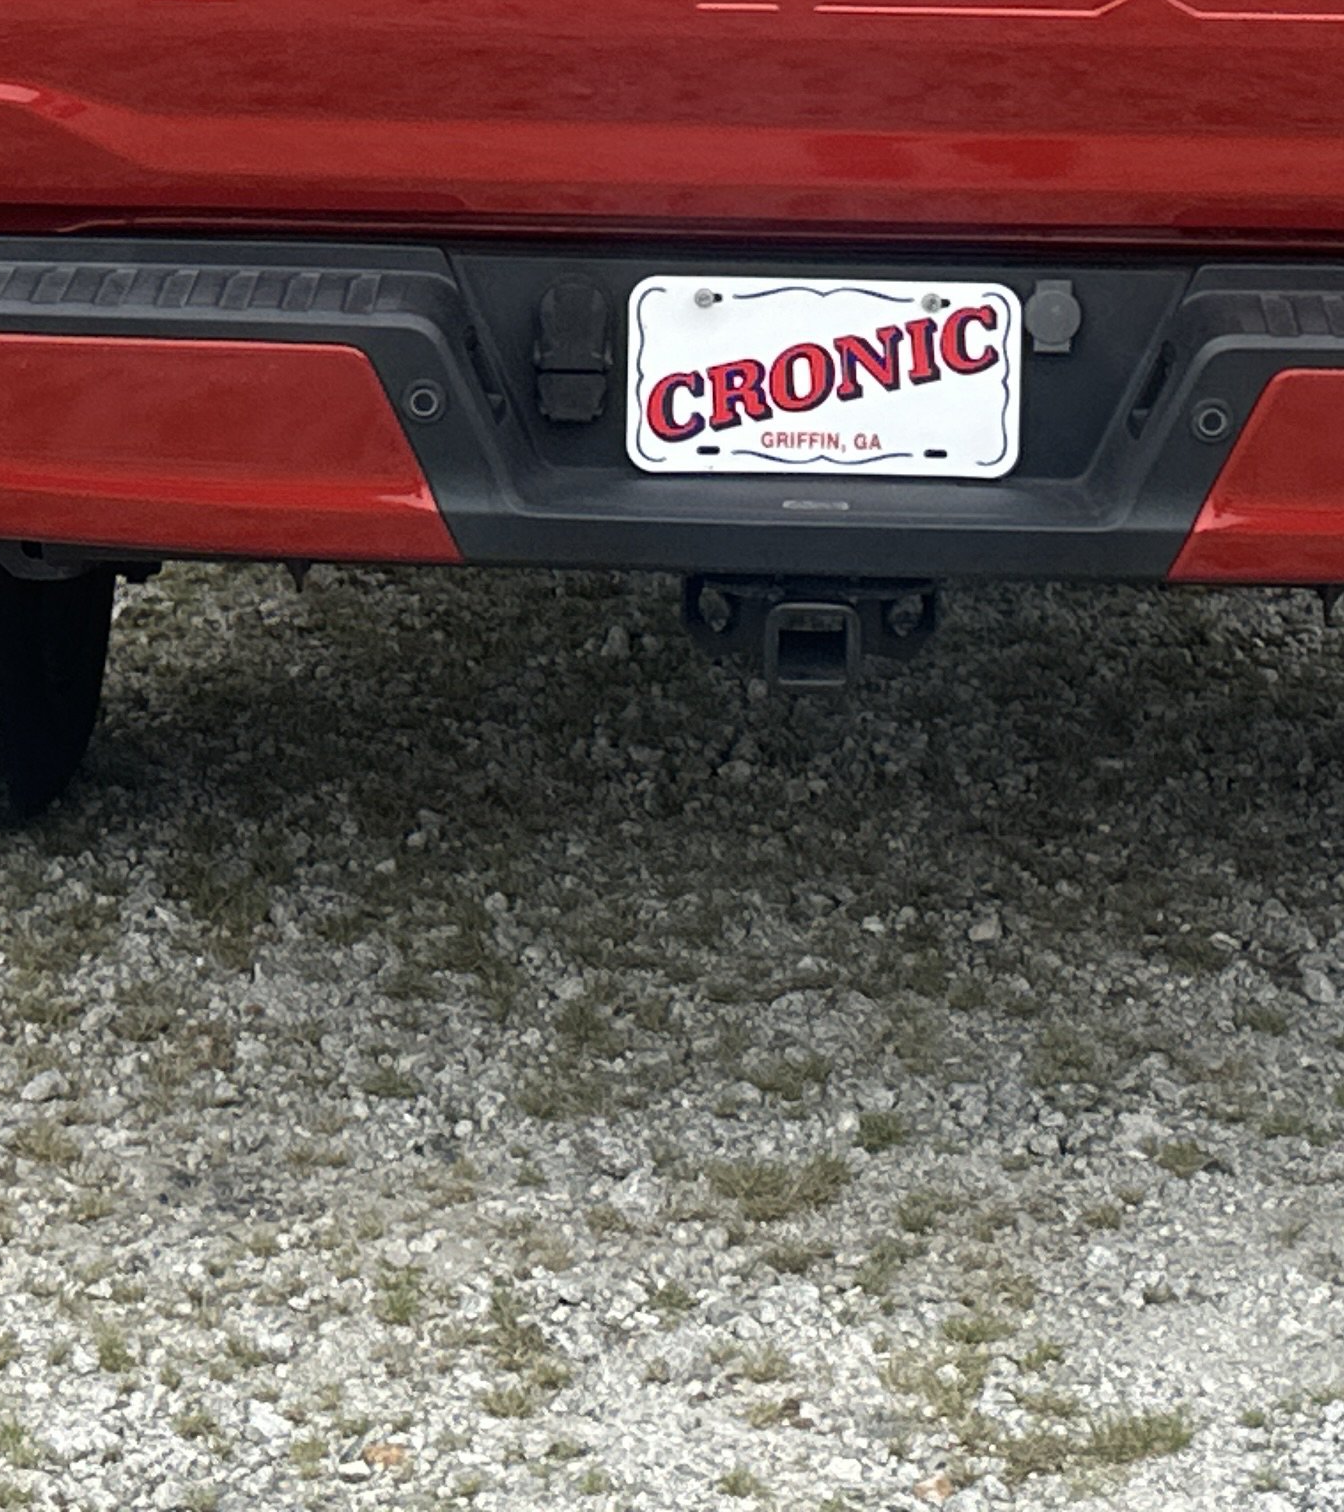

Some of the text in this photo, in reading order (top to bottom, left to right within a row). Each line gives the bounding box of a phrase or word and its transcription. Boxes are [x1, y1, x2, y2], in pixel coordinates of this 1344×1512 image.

[647, 304, 999, 443] CRONIC
[760, 431, 882, 453] GRIFFIN, GA
